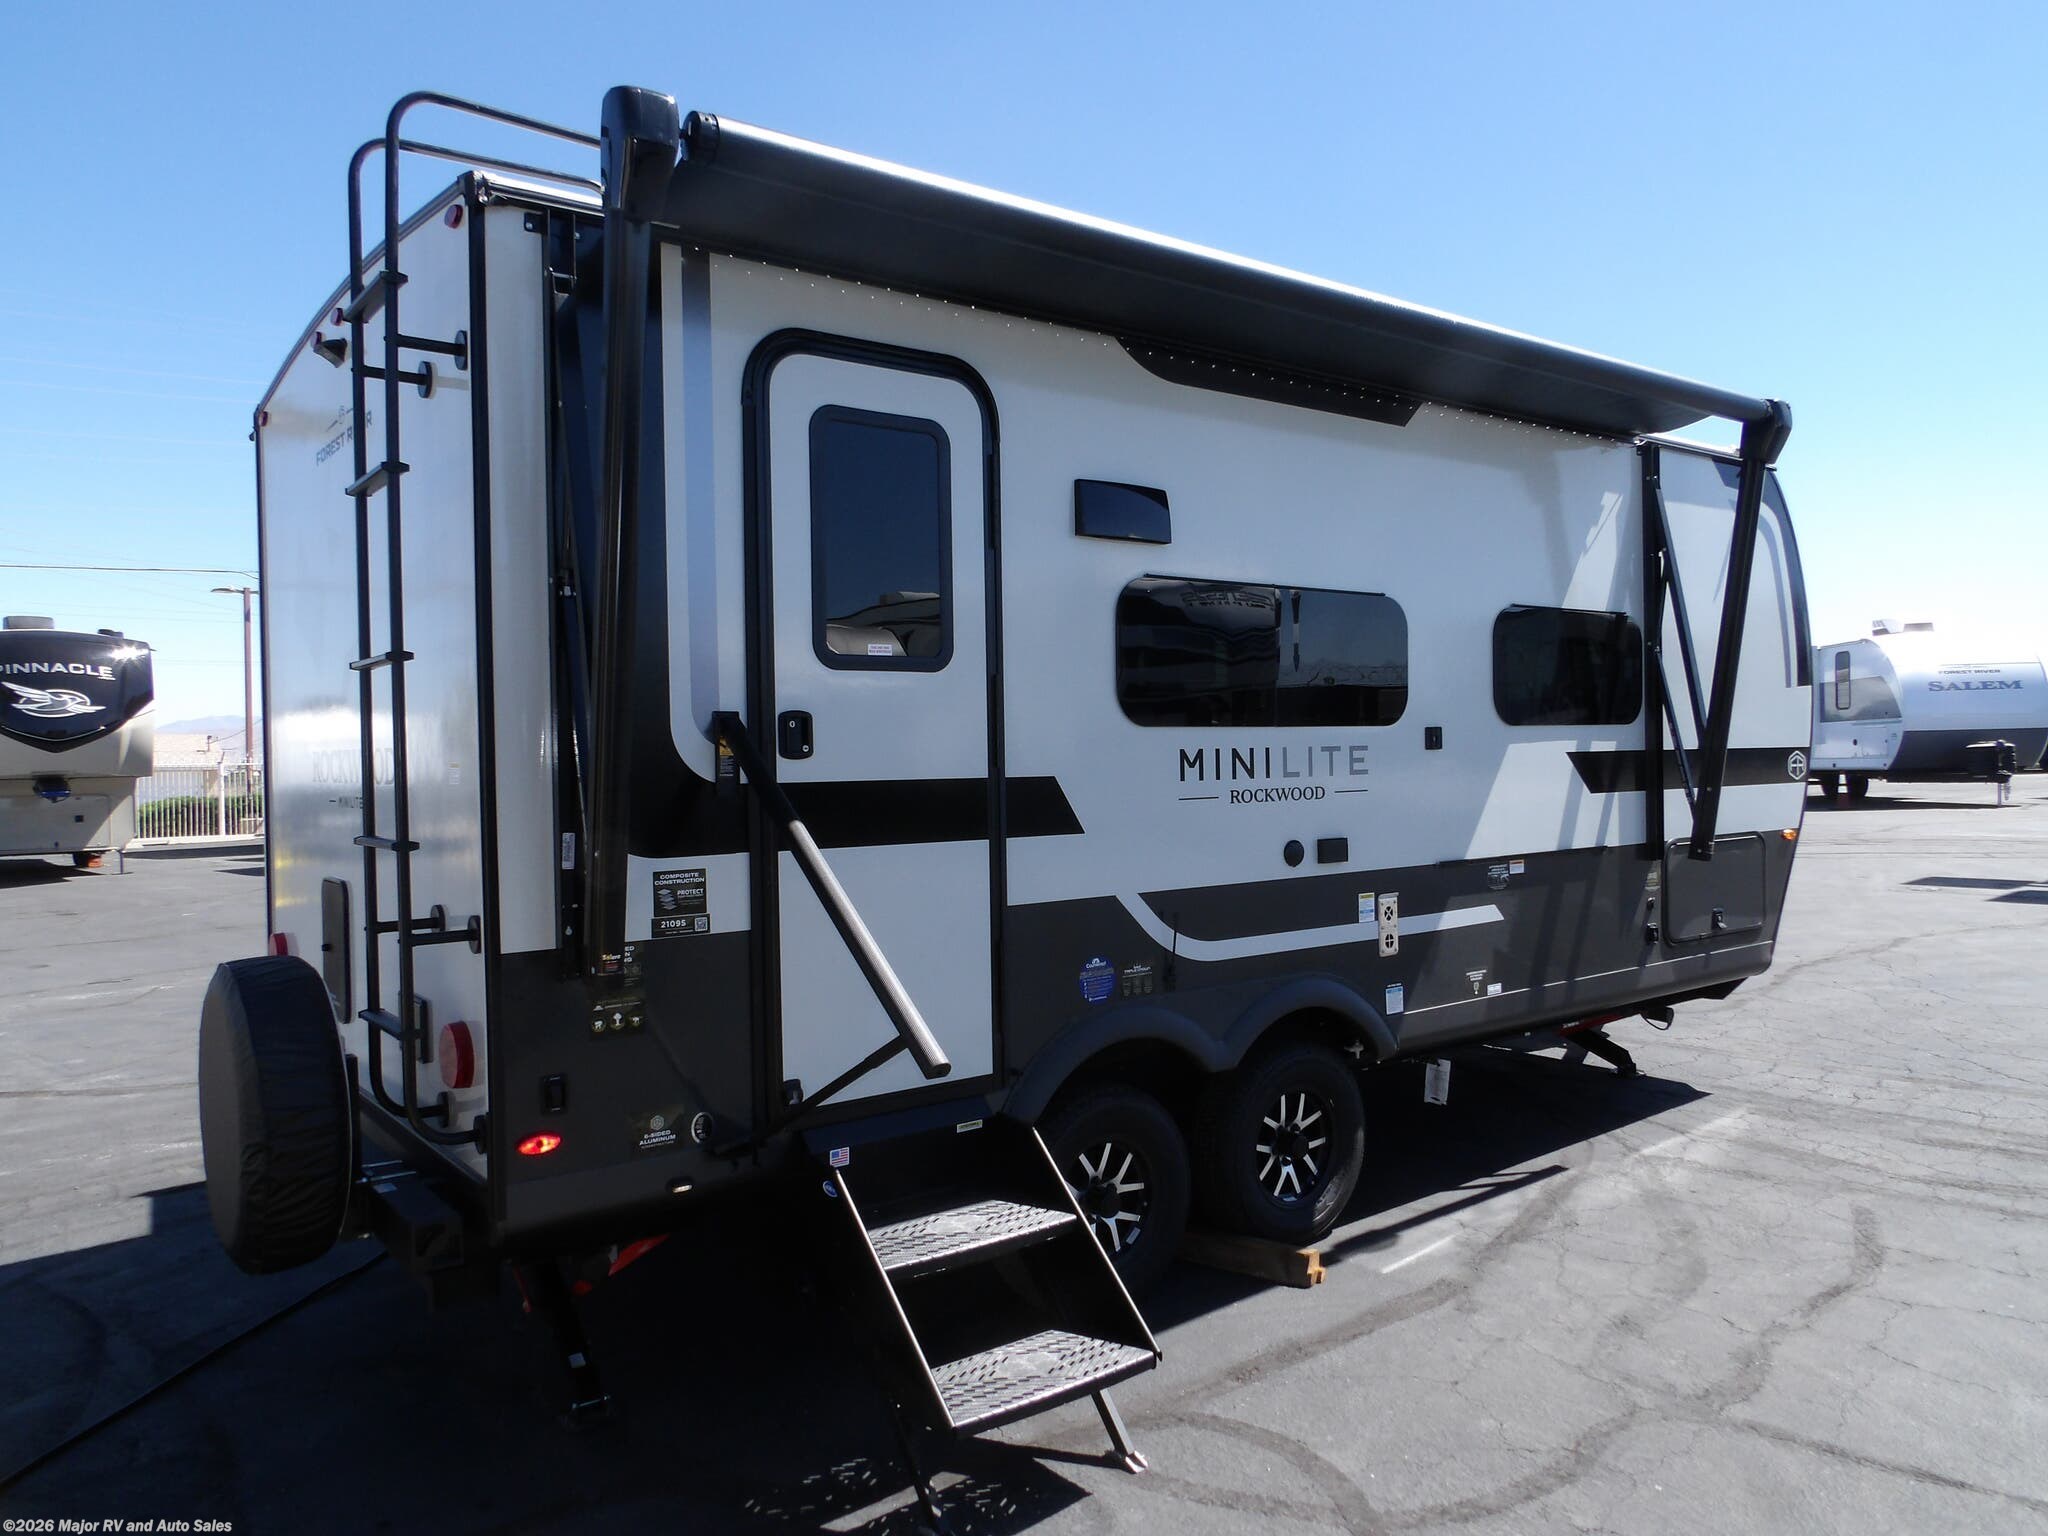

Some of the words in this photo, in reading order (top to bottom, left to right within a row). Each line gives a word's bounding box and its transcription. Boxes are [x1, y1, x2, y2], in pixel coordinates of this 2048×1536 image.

[1928, 680, 2024, 692] SALEM
[1179, 745, 1369, 782] MINILITE
[1230, 786, 1326, 804] ROCKWOOD
[654, 877, 705, 886] CONSTRUCTION
[660, 872, 700, 880] COMPOSITE
[639, 1134, 676, 1145] ALUMINUM
